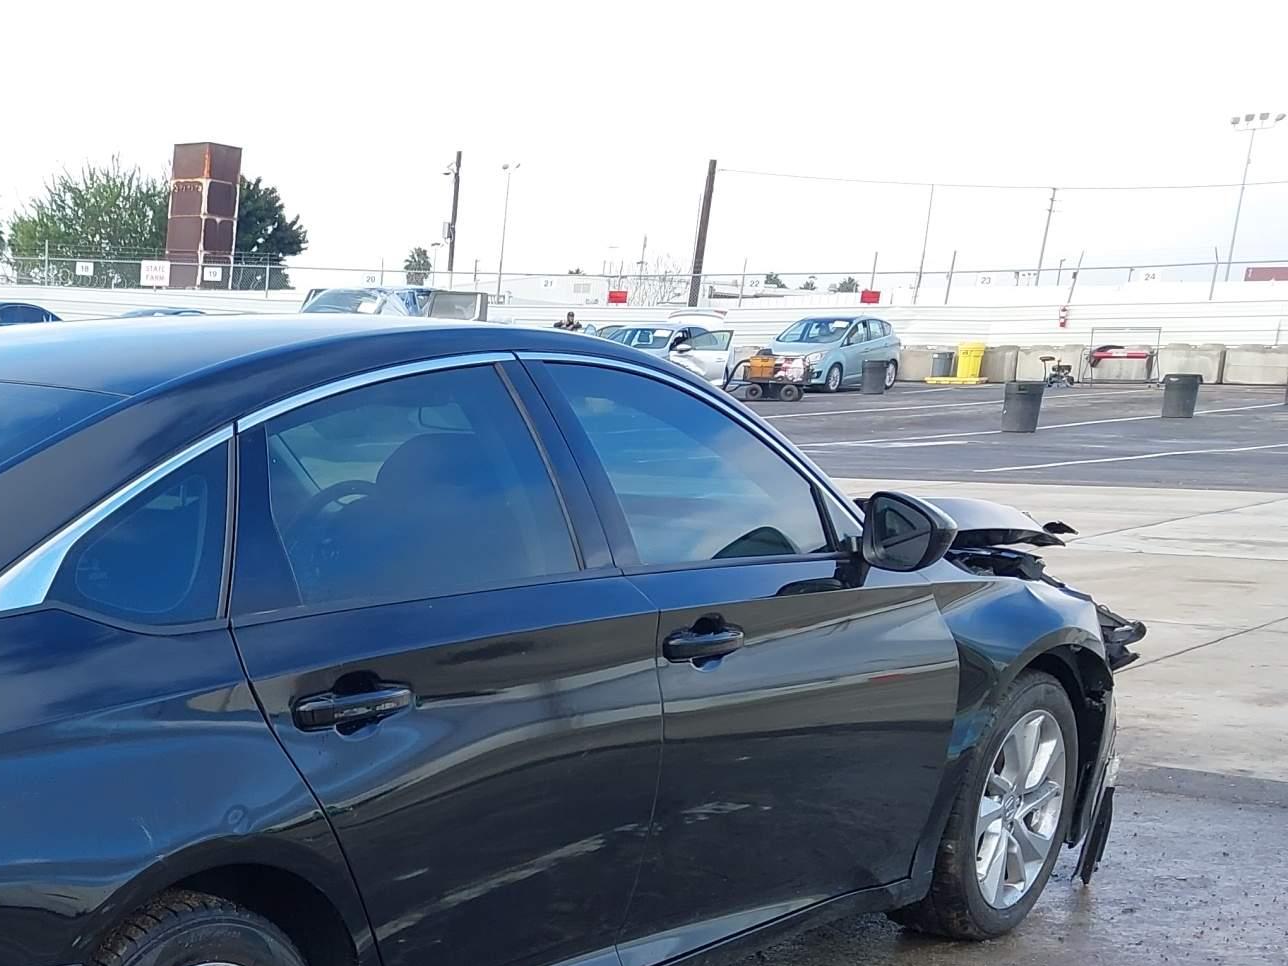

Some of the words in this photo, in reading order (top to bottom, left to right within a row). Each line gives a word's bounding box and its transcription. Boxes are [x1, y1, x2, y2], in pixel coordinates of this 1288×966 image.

[366, 275, 376, 283] 20
[980, 276, 991, 285] 23
[1144, 273, 1156, 281] 24
[749, 279, 760, 287] 22
